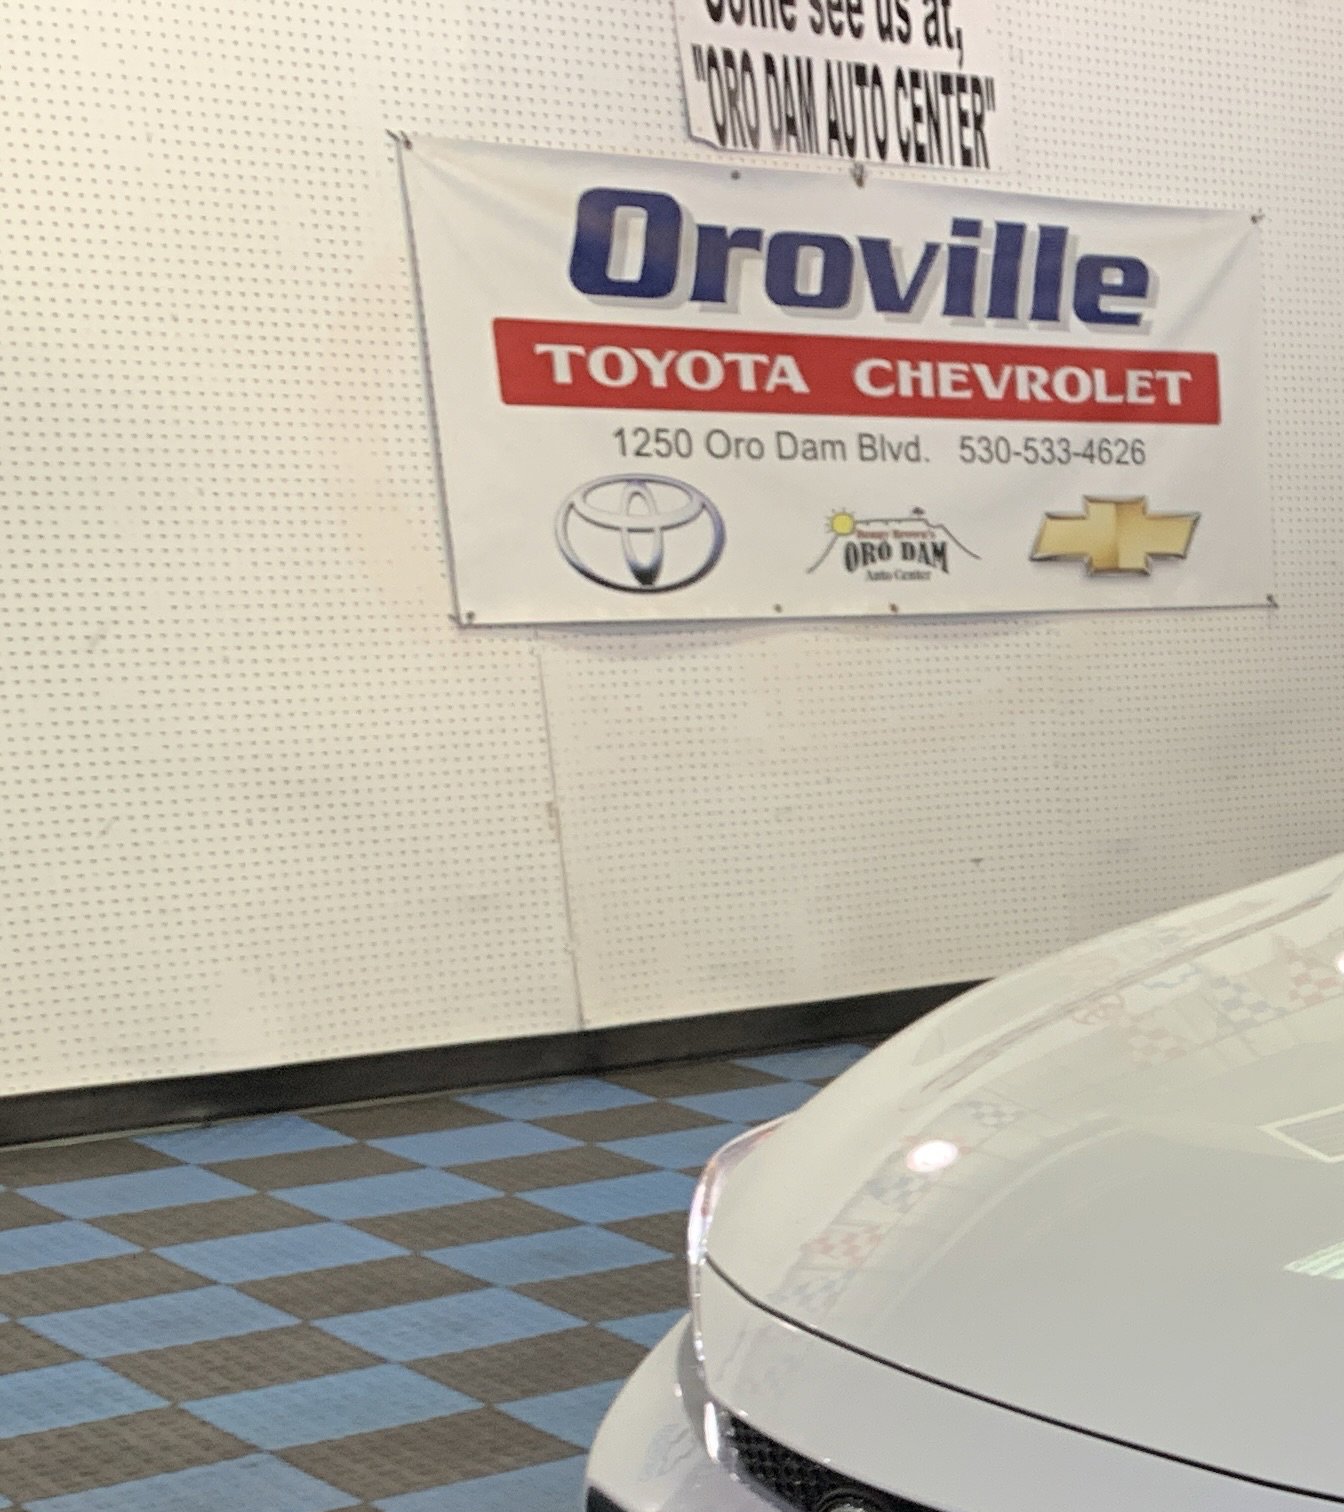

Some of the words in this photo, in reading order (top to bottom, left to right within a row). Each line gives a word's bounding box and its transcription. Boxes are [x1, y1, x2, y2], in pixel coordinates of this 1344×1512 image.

[705, 0, 797, 32] me
[806, 0, 865, 38] see
[876, 0, 912, 45] us
[691, 43, 760, 149] "ORO
[764, 52, 821, 154] DAM
[826, 59, 888, 161] AUTO
[895, 65, 995, 169] CENTER"
[569, 186, 1151, 326] Oroville
[534, 343, 810, 394] TOYOTA
[853, 358, 1193, 405] CHEVROLET
[613, 427, 693, 459] 1250
[705, 429, 765, 460] Oro
[776, 431, 847, 461] Dam
[858, 432, 930, 462] Blvd.
[959, 435, 1146, 466] 530-533-4626
[844, 540, 893, 573] ORO
[900, 540, 949, 574] DAM
